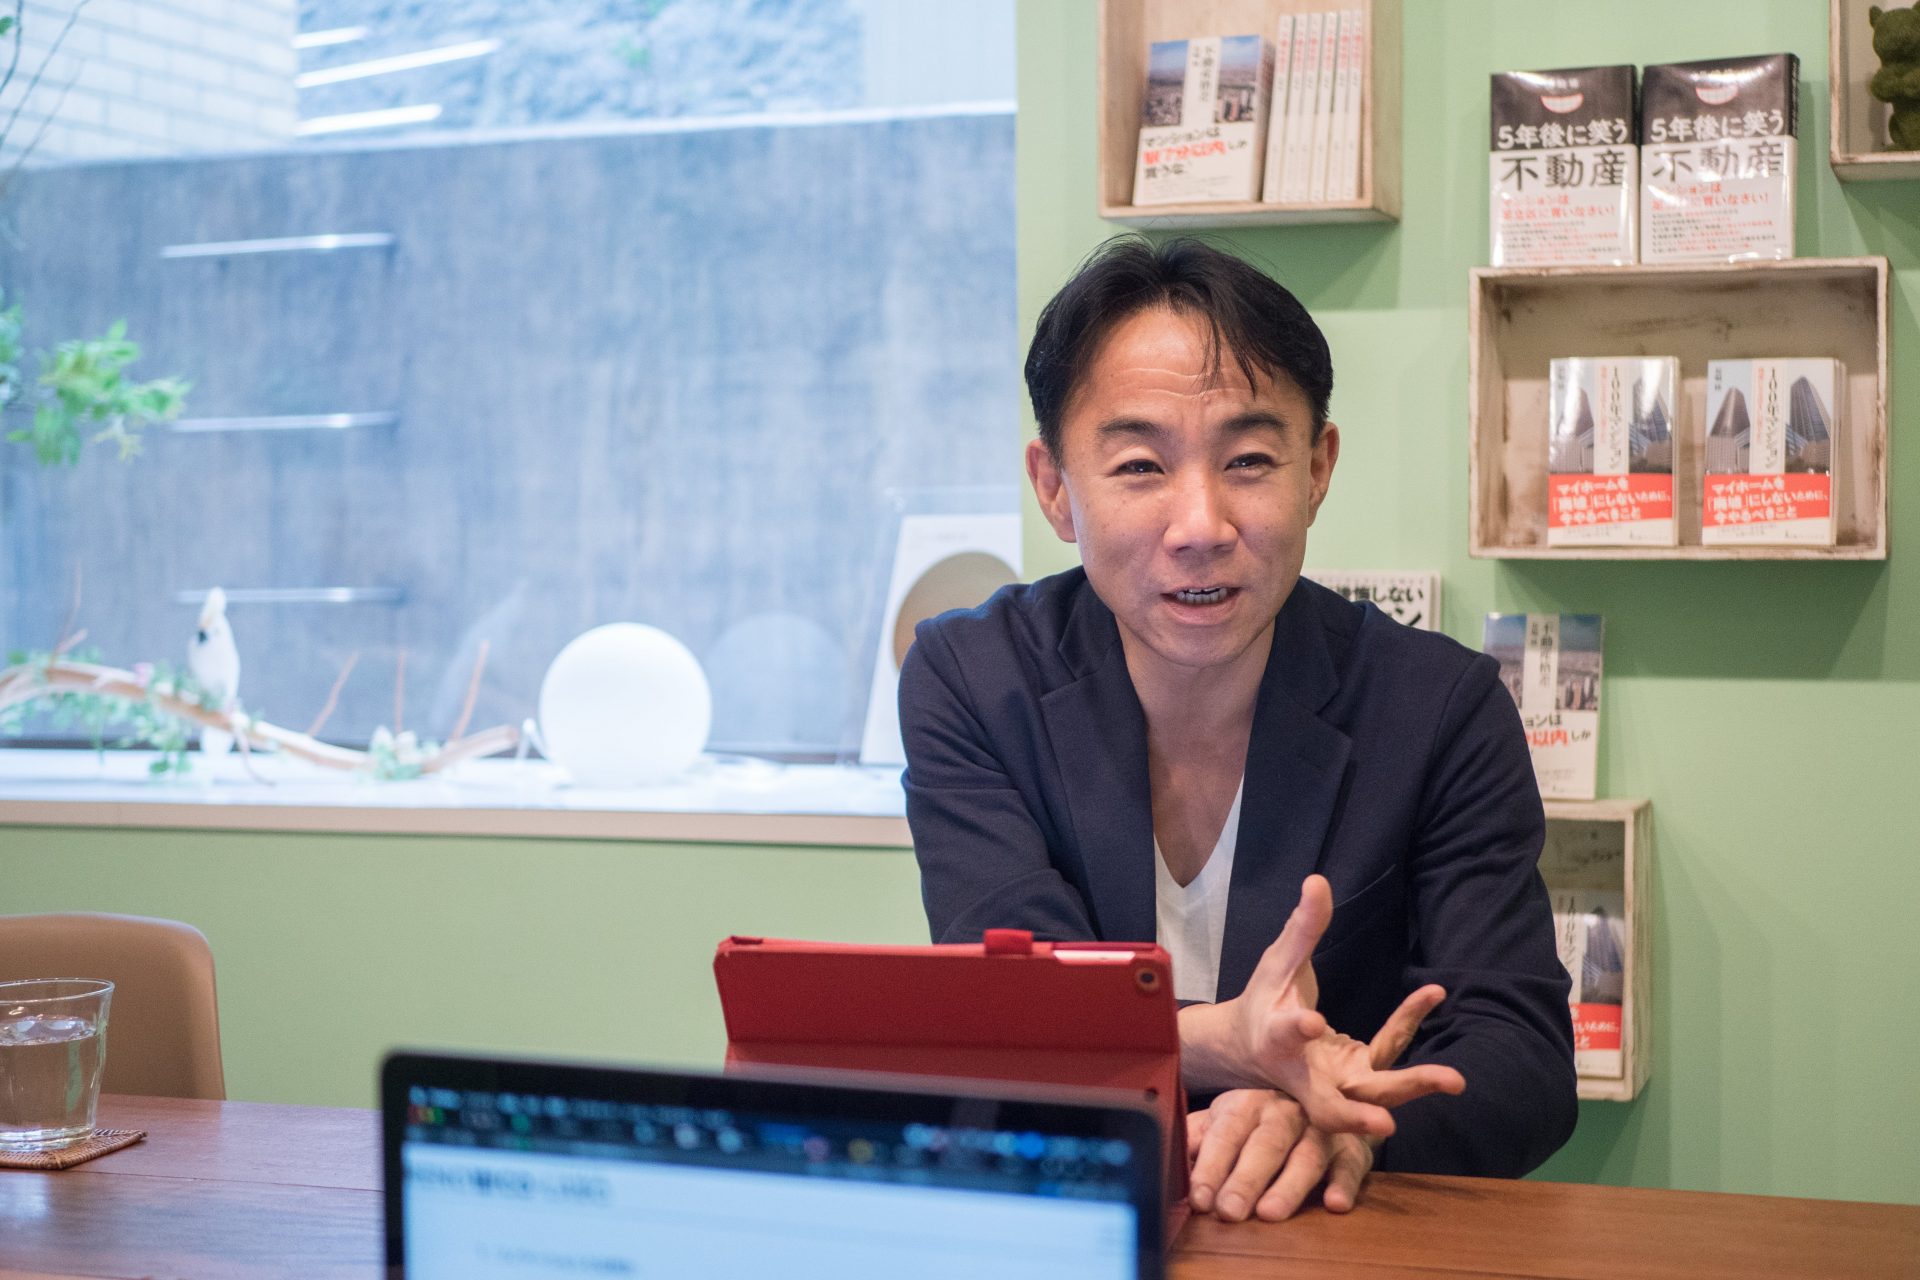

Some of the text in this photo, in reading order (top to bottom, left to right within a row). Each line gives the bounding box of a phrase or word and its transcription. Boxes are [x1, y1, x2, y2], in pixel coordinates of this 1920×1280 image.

[1497, 118, 1629, 149] 5年後に笑う
[1650, 109, 1784, 142] 5年後に笑う
[1500, 150, 1626, 191] 不動産
[1652, 140, 1784, 183] 不動産
